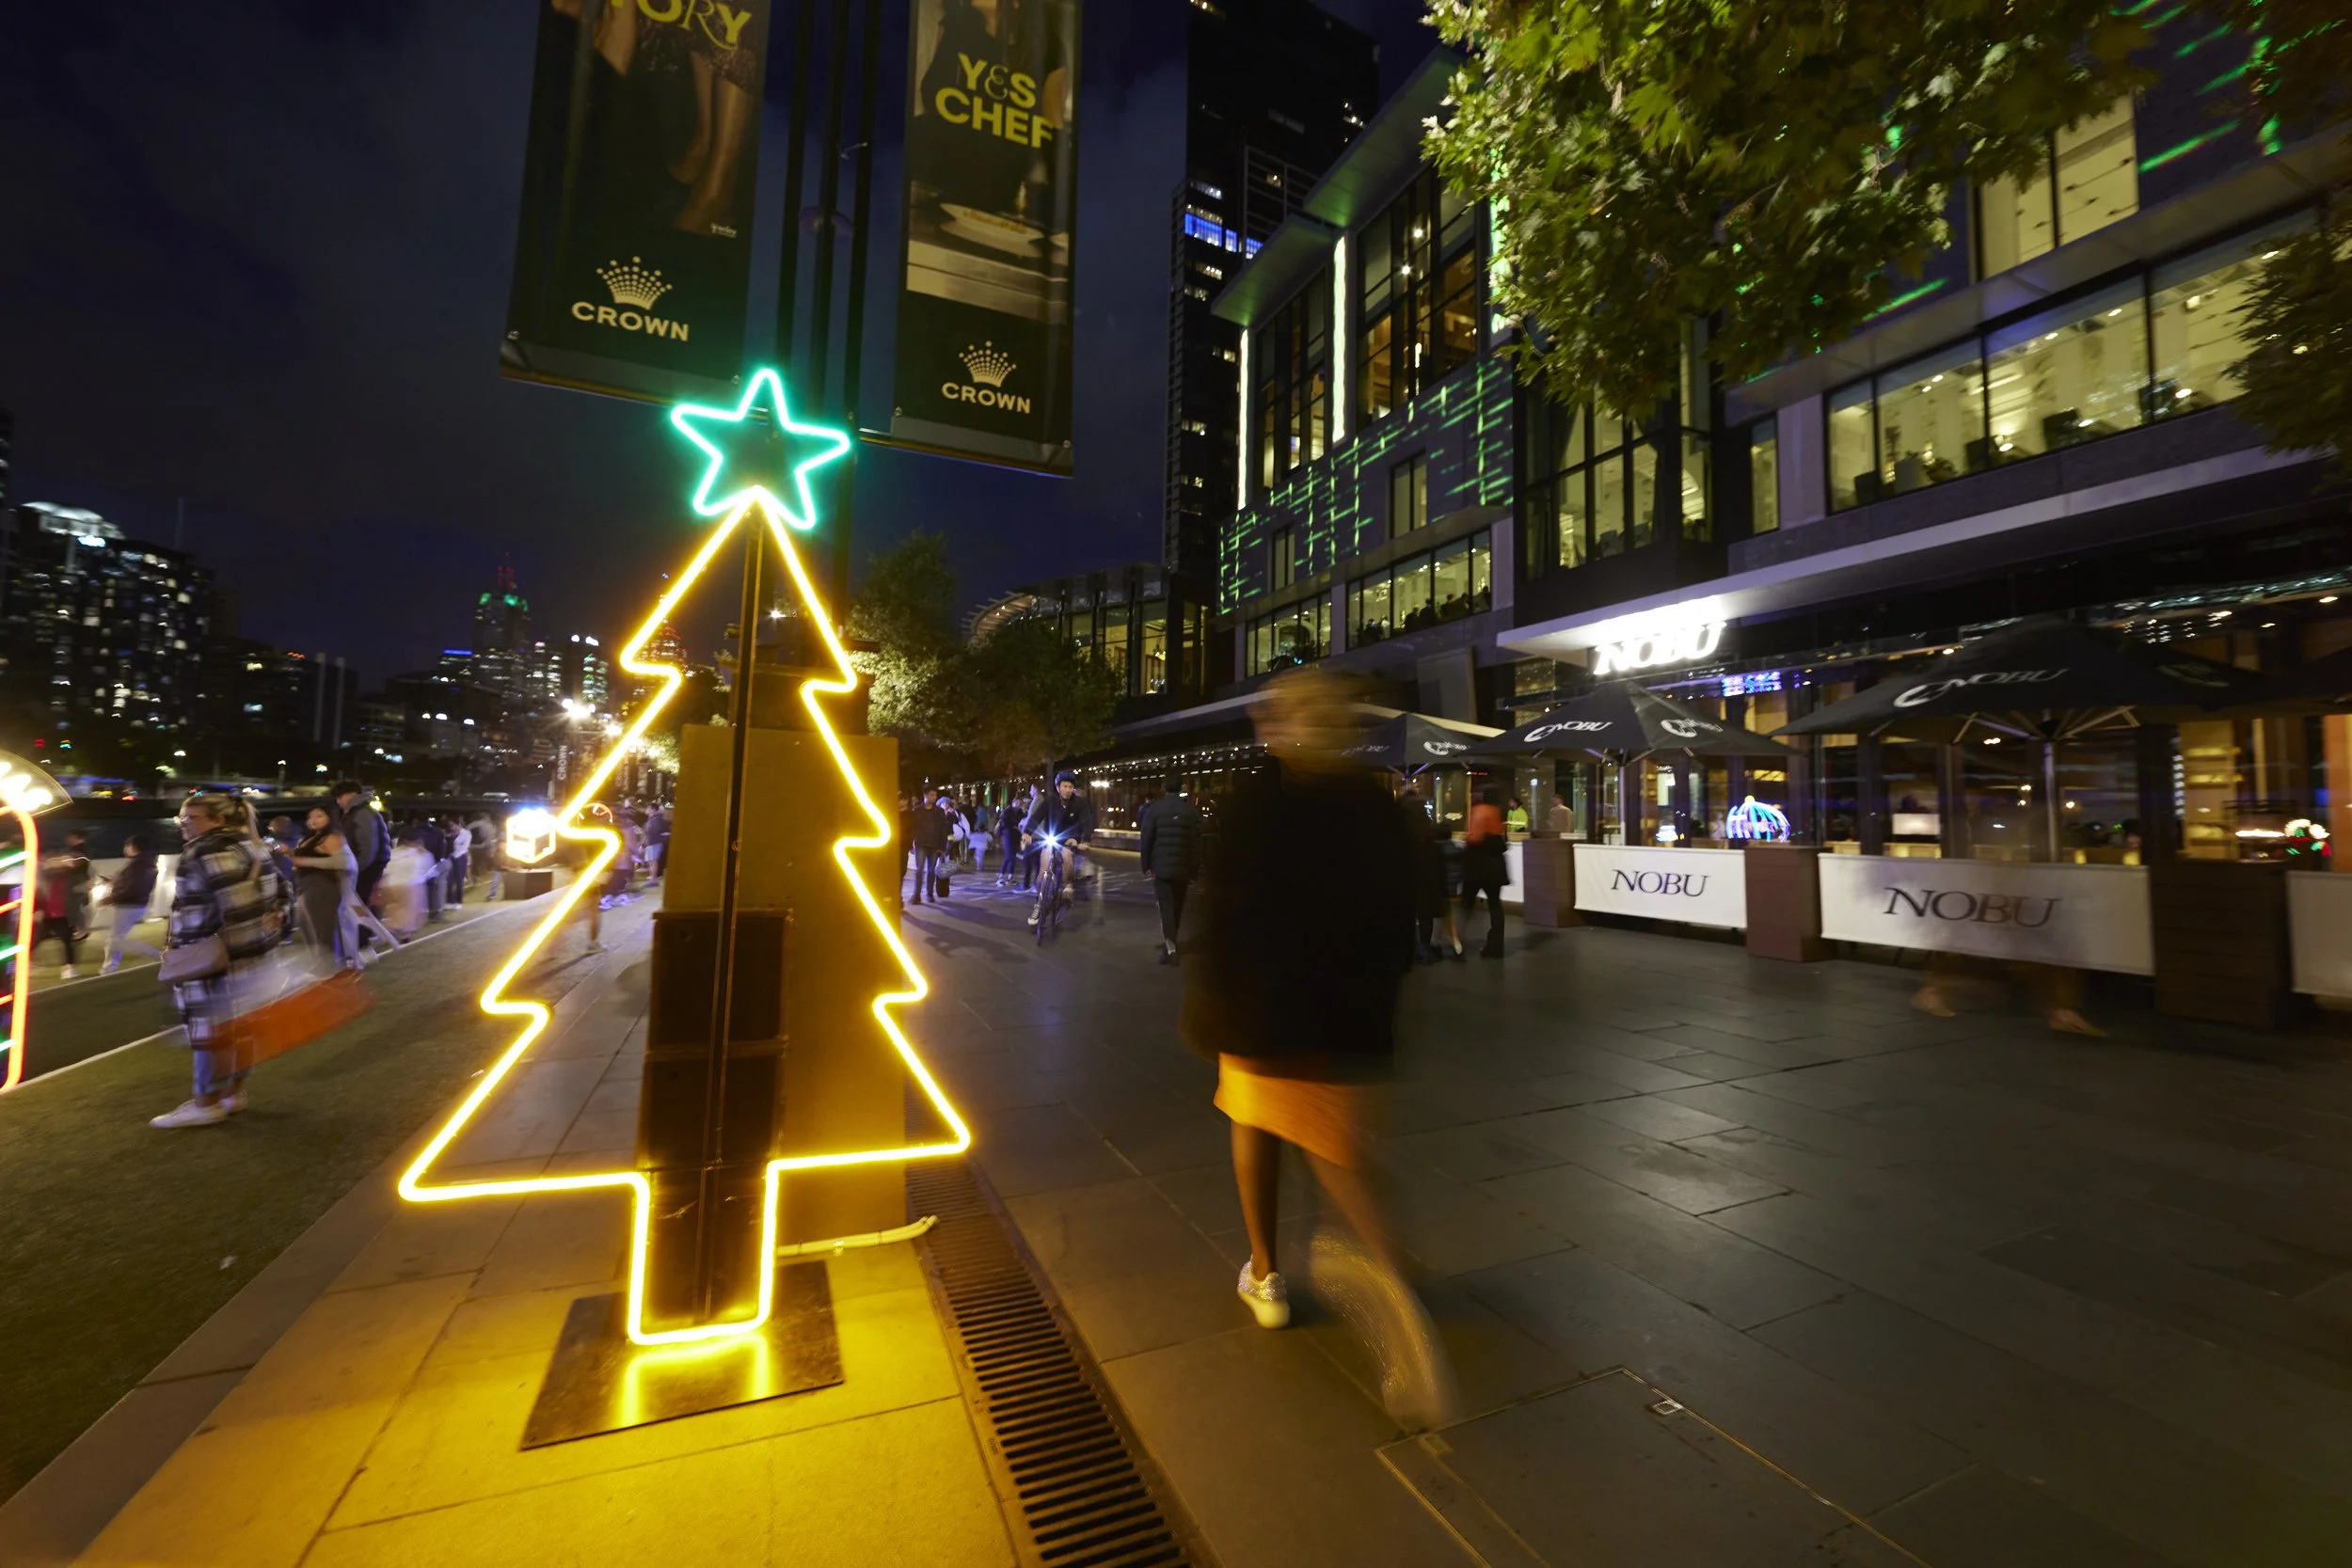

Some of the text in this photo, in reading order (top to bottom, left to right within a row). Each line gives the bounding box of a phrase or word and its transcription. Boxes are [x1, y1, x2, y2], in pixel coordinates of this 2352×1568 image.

[612, 0, 752, 50] ORY
[935, 87, 1054, 148] CHEF
[571, 301, 689, 341] CROWN
[942, 382, 1030, 414] CROWN
[1593, 621, 1727, 675] NOBU
[1553, 721, 1614, 732] NOBU
[1611, 869, 1710, 897] NOBU
[1883, 887, 2061, 927] NOBU
